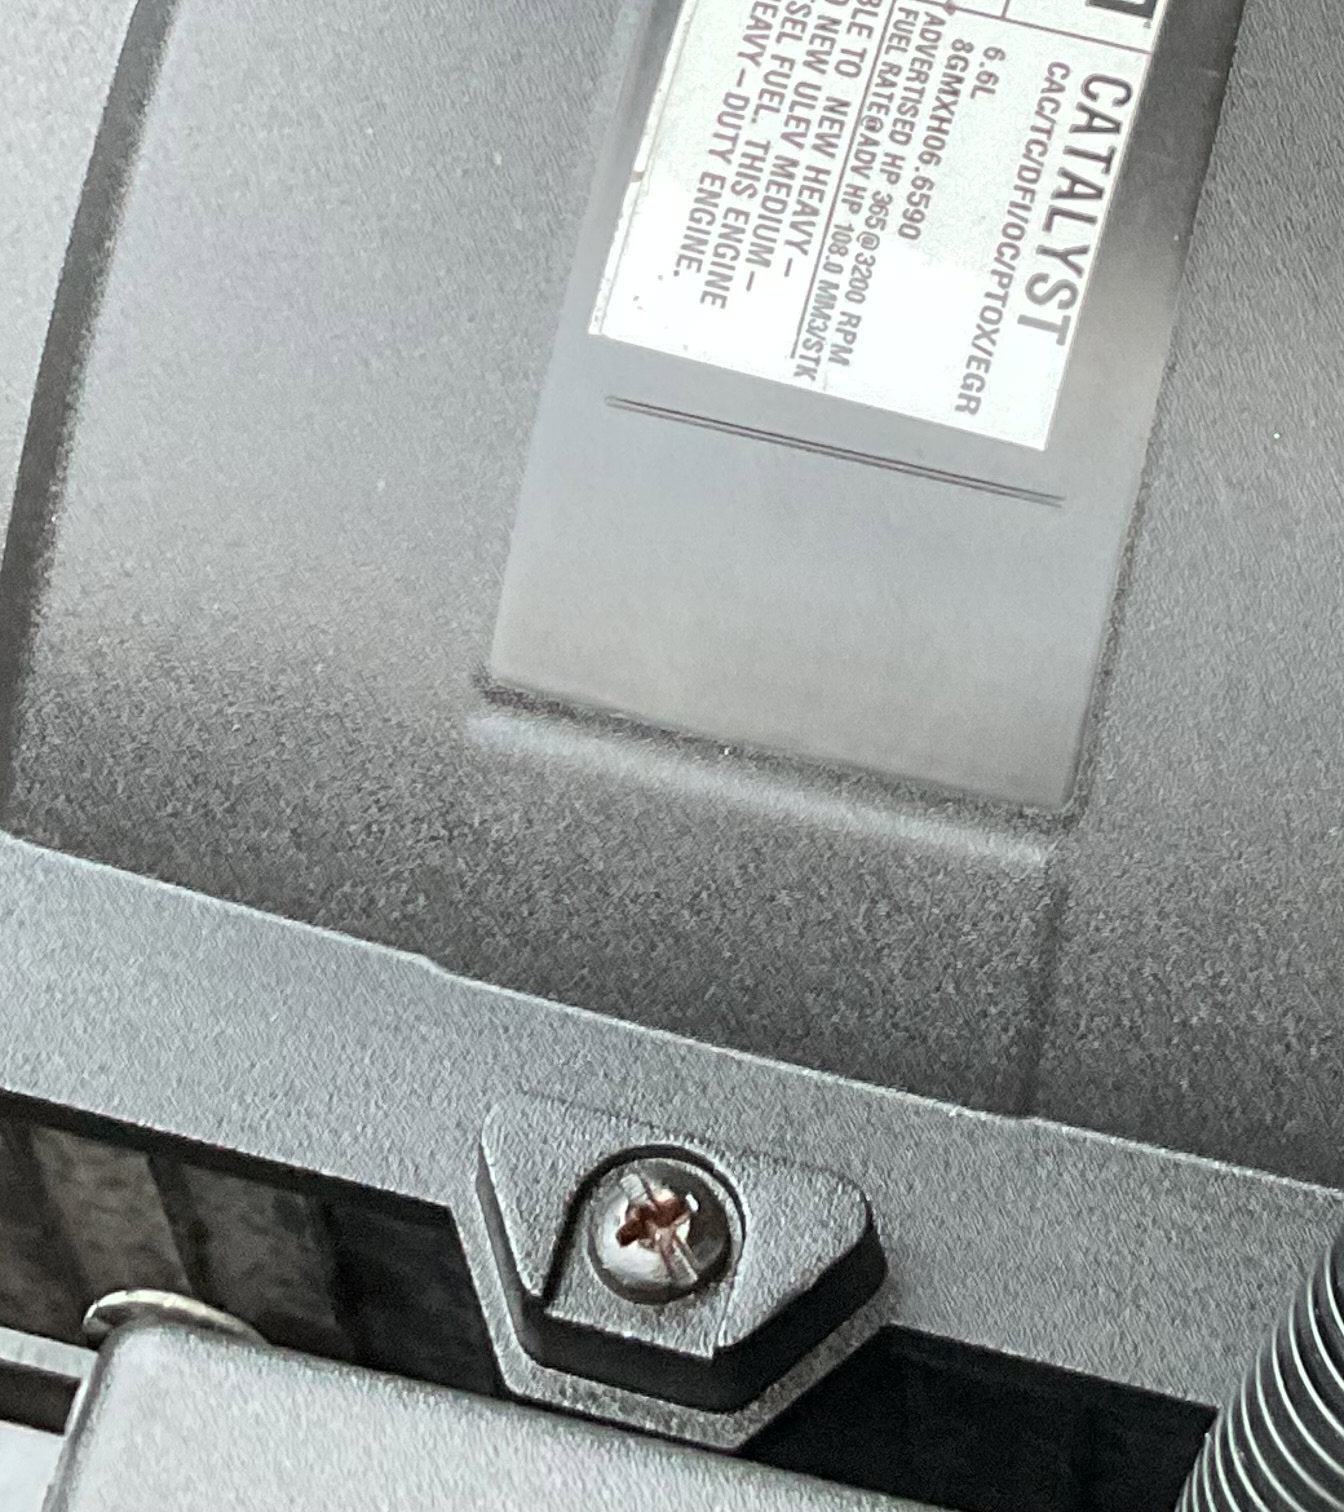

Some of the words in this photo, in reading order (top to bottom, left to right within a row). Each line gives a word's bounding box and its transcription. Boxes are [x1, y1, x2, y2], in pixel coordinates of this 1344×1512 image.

[801, 13, 842, 75] NEW
[832, 45, 868, 80] TO
[883, 5, 919, 59] FUEL
[749, 52, 796, 123] FUEL.
[886, 10, 947, 147] ADVERTISED
[968, 44, 1007, 104] 6.6L
[778, 79, 823, 150] ULEV
[809, 95, 851, 159] NEW
[847, 60, 902, 179] RATE@ADV
[896, 36, 974, 242] 8GMXH06.6590
[728, 139, 772, 201] THIS
[838, 182, 867, 216] HP
[875, 150, 906, 186] HP
[671, 171, 726, 276] ENGINE.
[952, 59, 1072, 416] CAC/TC/DFI/OC/PTOX/EGR
[1015, 70, 1135, 347] CATALYST
[698, 206, 751, 310] ENGINE
[821, 219, 855, 276] 108.0
[791, 278, 841, 382] MM3/STK
[825, 310, 861, 367] RPM
